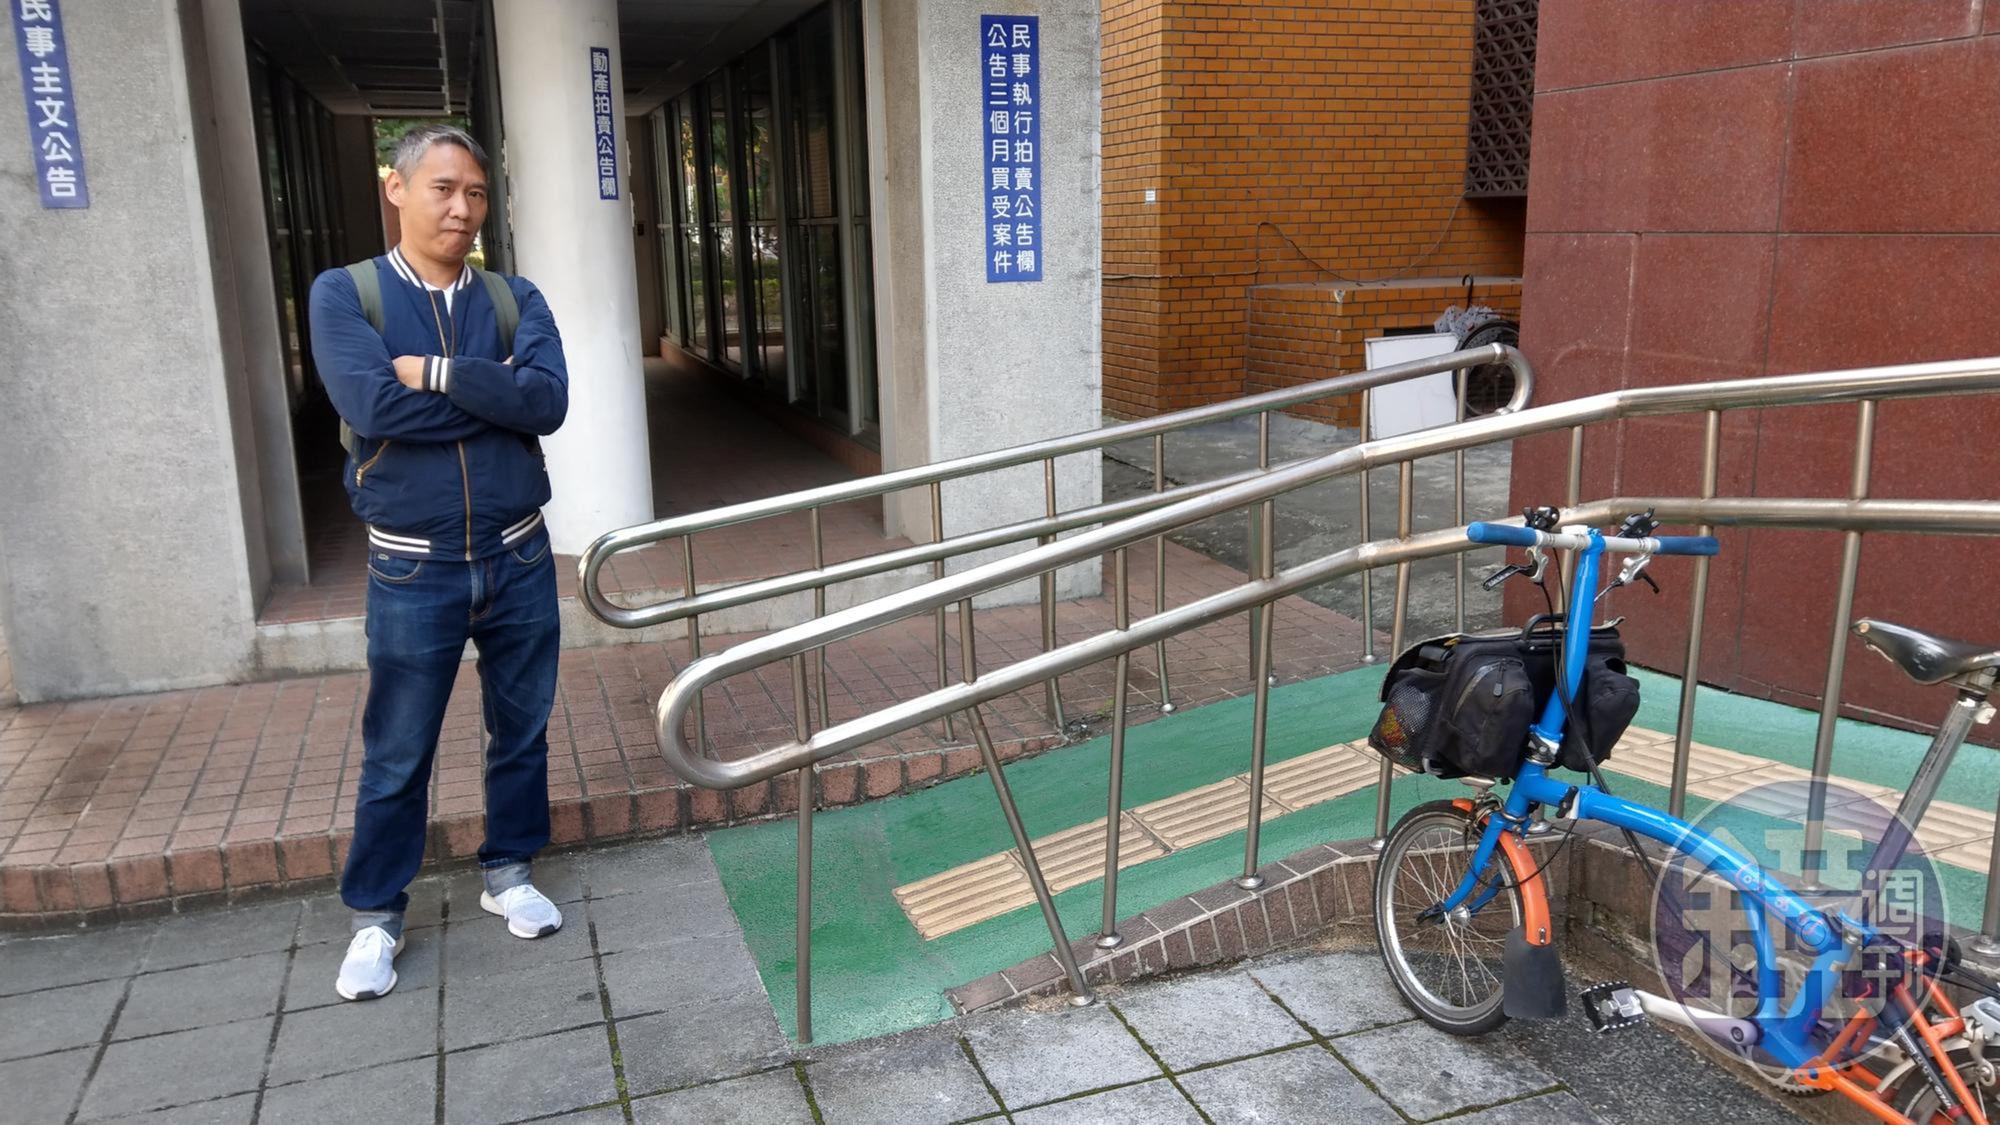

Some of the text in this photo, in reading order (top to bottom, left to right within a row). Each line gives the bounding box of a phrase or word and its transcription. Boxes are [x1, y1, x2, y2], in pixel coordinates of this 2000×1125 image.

[20, 0, 77, 197] 民事主文公告
[592, 52, 617, 197] 動產拍賣公告欄
[987, 23, 1012, 274] 公告三個月買受案件
[1011, 24, 1035, 273] 民事執行拍賣公告欄
